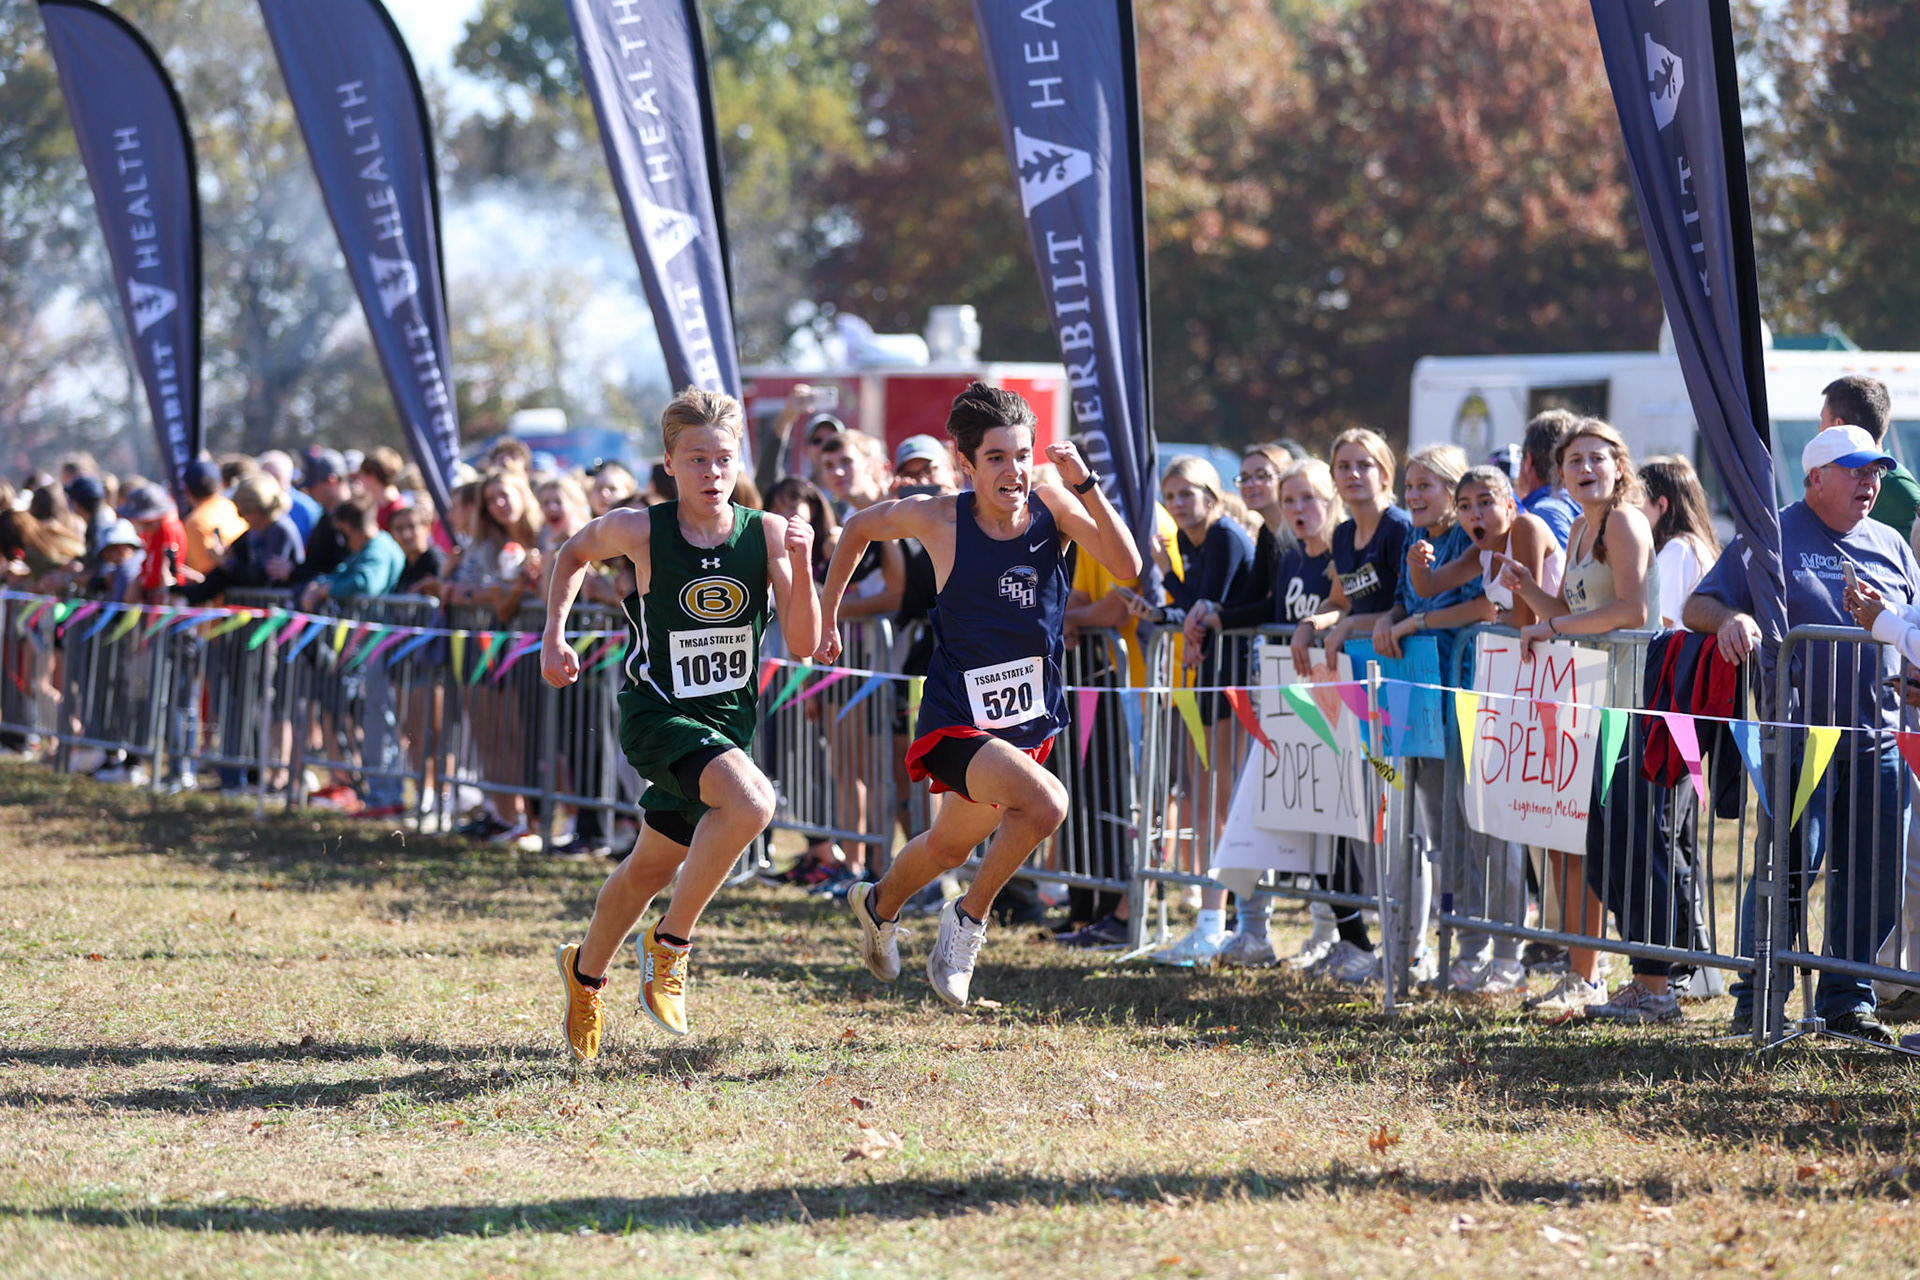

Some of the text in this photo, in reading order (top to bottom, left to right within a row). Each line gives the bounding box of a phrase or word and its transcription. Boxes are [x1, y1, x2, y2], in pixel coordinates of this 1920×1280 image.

[1020, 0, 1065, 108] HEA
[614, 0, 674, 184] HEALTH
[336, 80, 403, 241] HEALTH
[113, 126, 160, 269] HEALTH
[695, 585, 734, 614] B
[1001, 576, 1034, 606] SBA
[679, 634, 746, 649] TMSAA STATE XC
[676, 649, 747, 687] 1039
[974, 664, 1034, 686] TSSAA STATE XC
[1265, 656, 1295, 718] I
[1477, 648, 1508, 715] I
[1511, 649, 1577, 728] AM
[982, 682, 1033, 721] 520
[1262, 739, 1324, 813] POPE
[645, 952, 654, 984] HOKA
